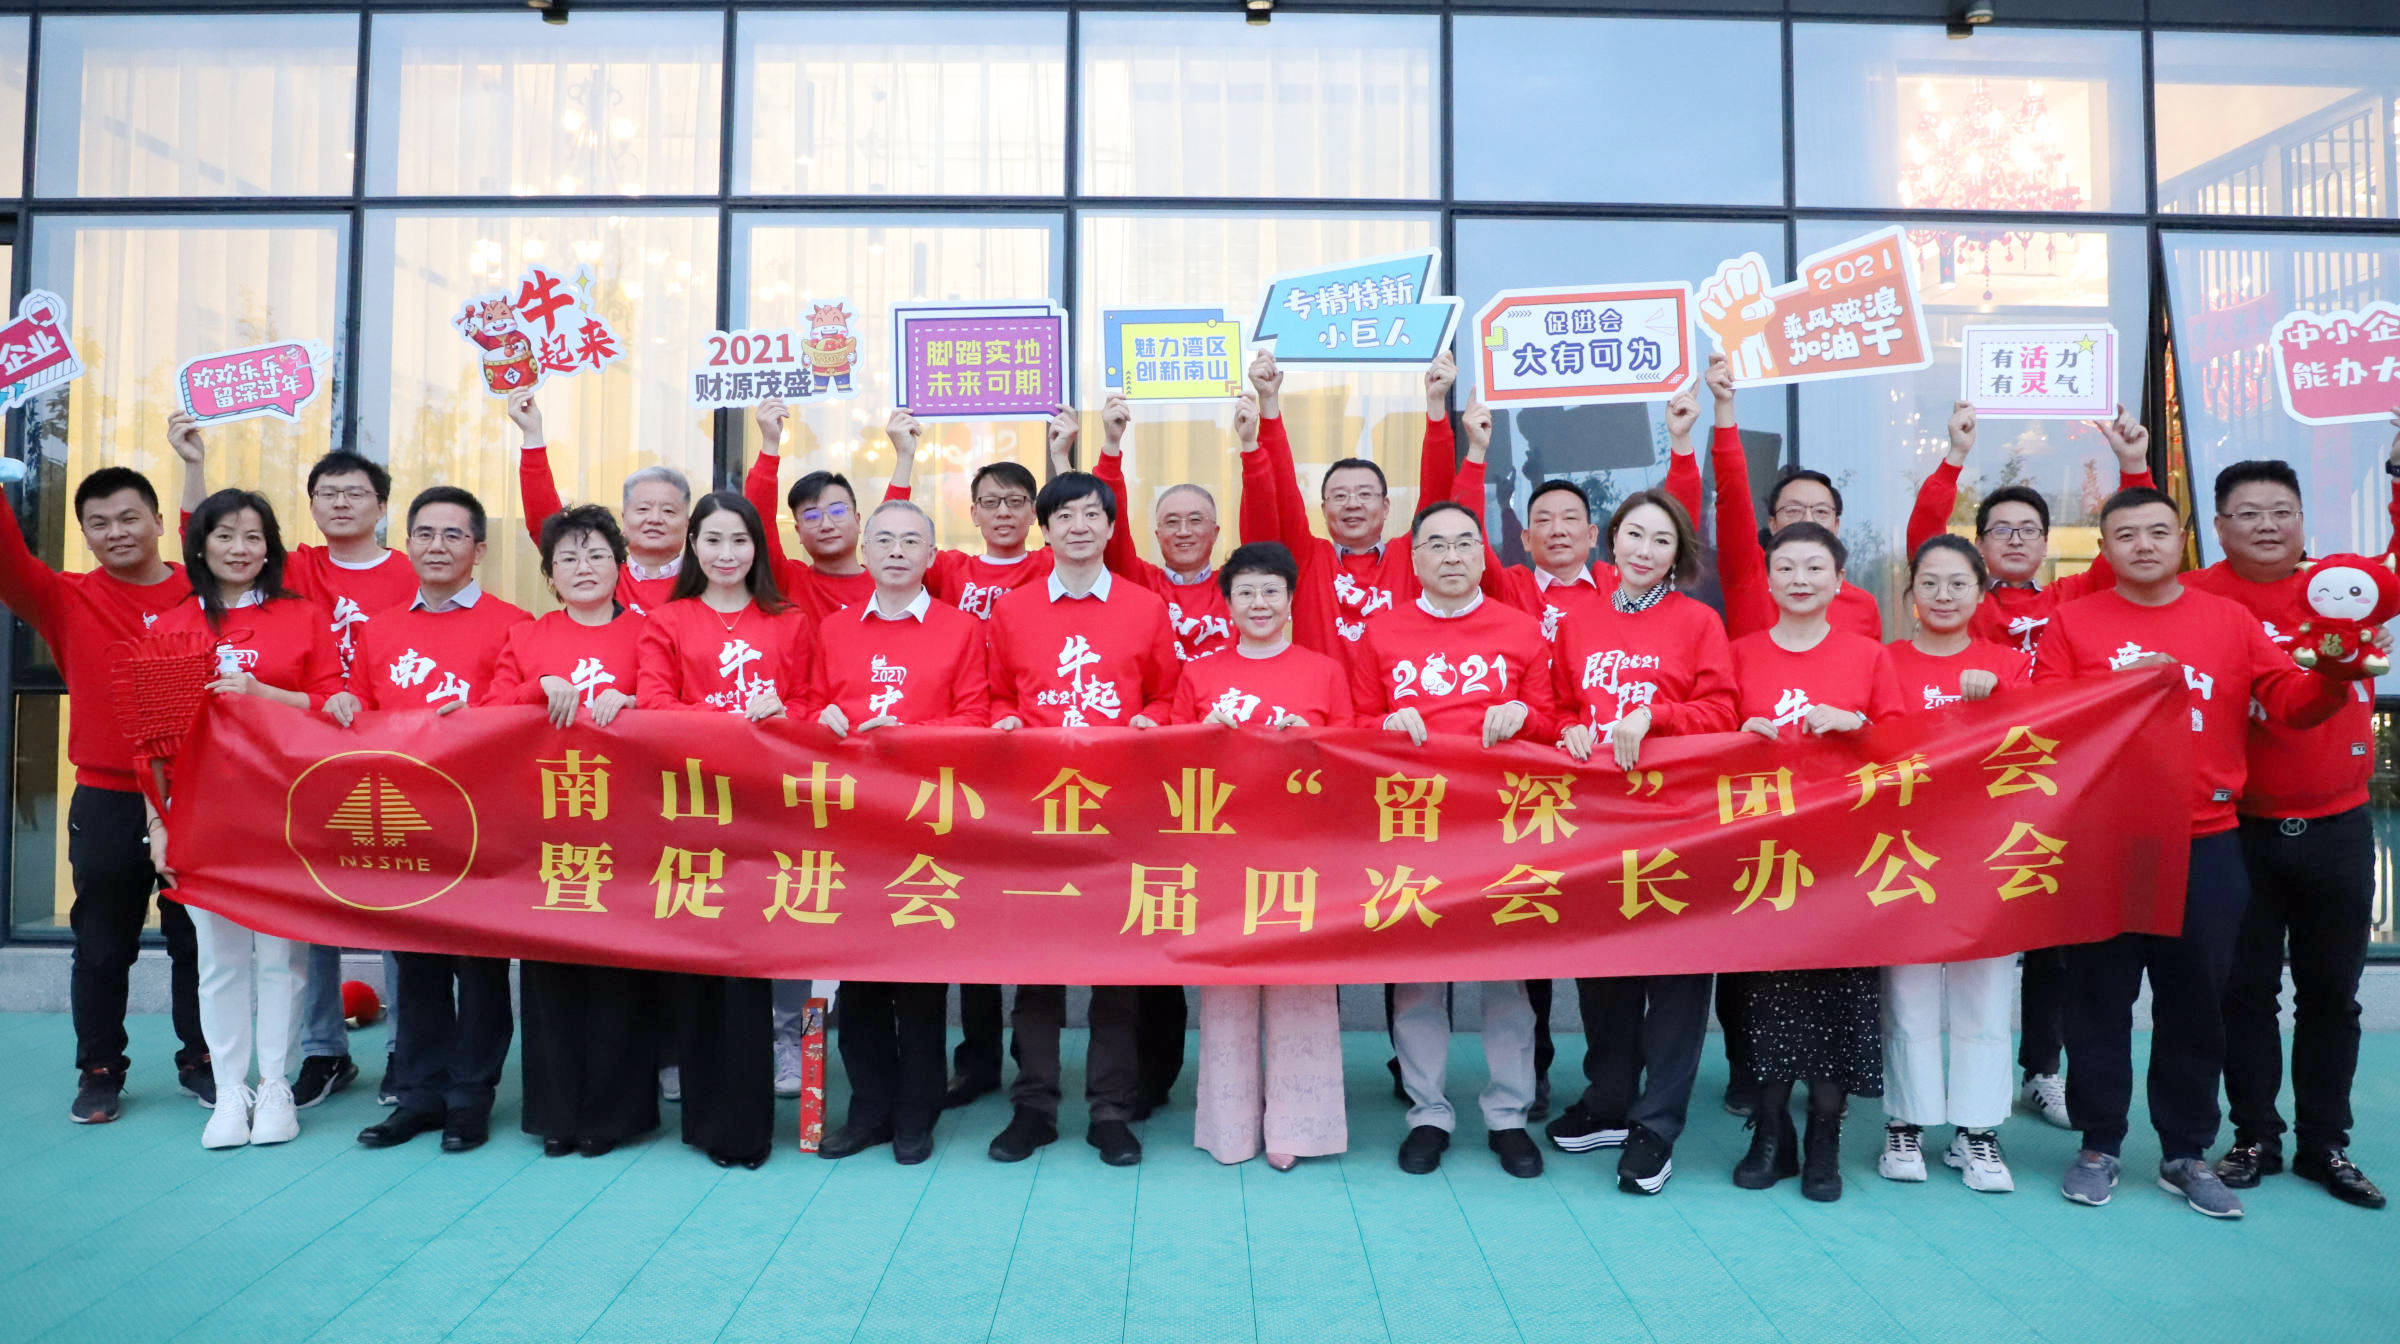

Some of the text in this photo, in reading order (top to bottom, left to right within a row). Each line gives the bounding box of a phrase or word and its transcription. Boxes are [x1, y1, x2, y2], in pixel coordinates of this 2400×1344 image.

[1813, 248, 1892, 290] 2021
[516, 269, 575, 338] 牛
[1283, 272, 1414, 320] 专精特新
[1318, 317, 1411, 349] 小巨人
[1545, 308, 1623, 335] 促进会
[538, 317, 620, 375] 起来
[708, 333, 794, 366] 2021
[926, 338, 1041, 367] 脚踏实地
[1134, 336, 1227, 358] 魅力湾区
[1512, 337, 1662, 377] 大有可为
[1788, 316, 1903, 365] 加油干
[1990, 345, 2078, 369] 有活力
[191, 354, 282, 388] 欢欢乐乐
[695, 367, 813, 402] 财源茂盛
[928, 369, 1041, 397] 未来可期
[1136, 360, 1229, 381] 创新南山
[1990, 371, 2080, 395] 有灵气
[213, 374, 303, 408] 留深过年
[330, 595, 371, 649] 牛
[389, 648, 470, 703] 南山
[718, 638, 762, 692] 牛
[871, 670, 902, 683] 2021
[1056, 634, 1102, 693] 牛
[570, 657, 616, 709] 牛
[1080, 674, 1122, 719] 起
[1772, 688, 1816, 727] 牛
[339, 855, 431, 873] NSSME
[531, 820, 2069, 937] 暨促进会一届四次会长办公会
